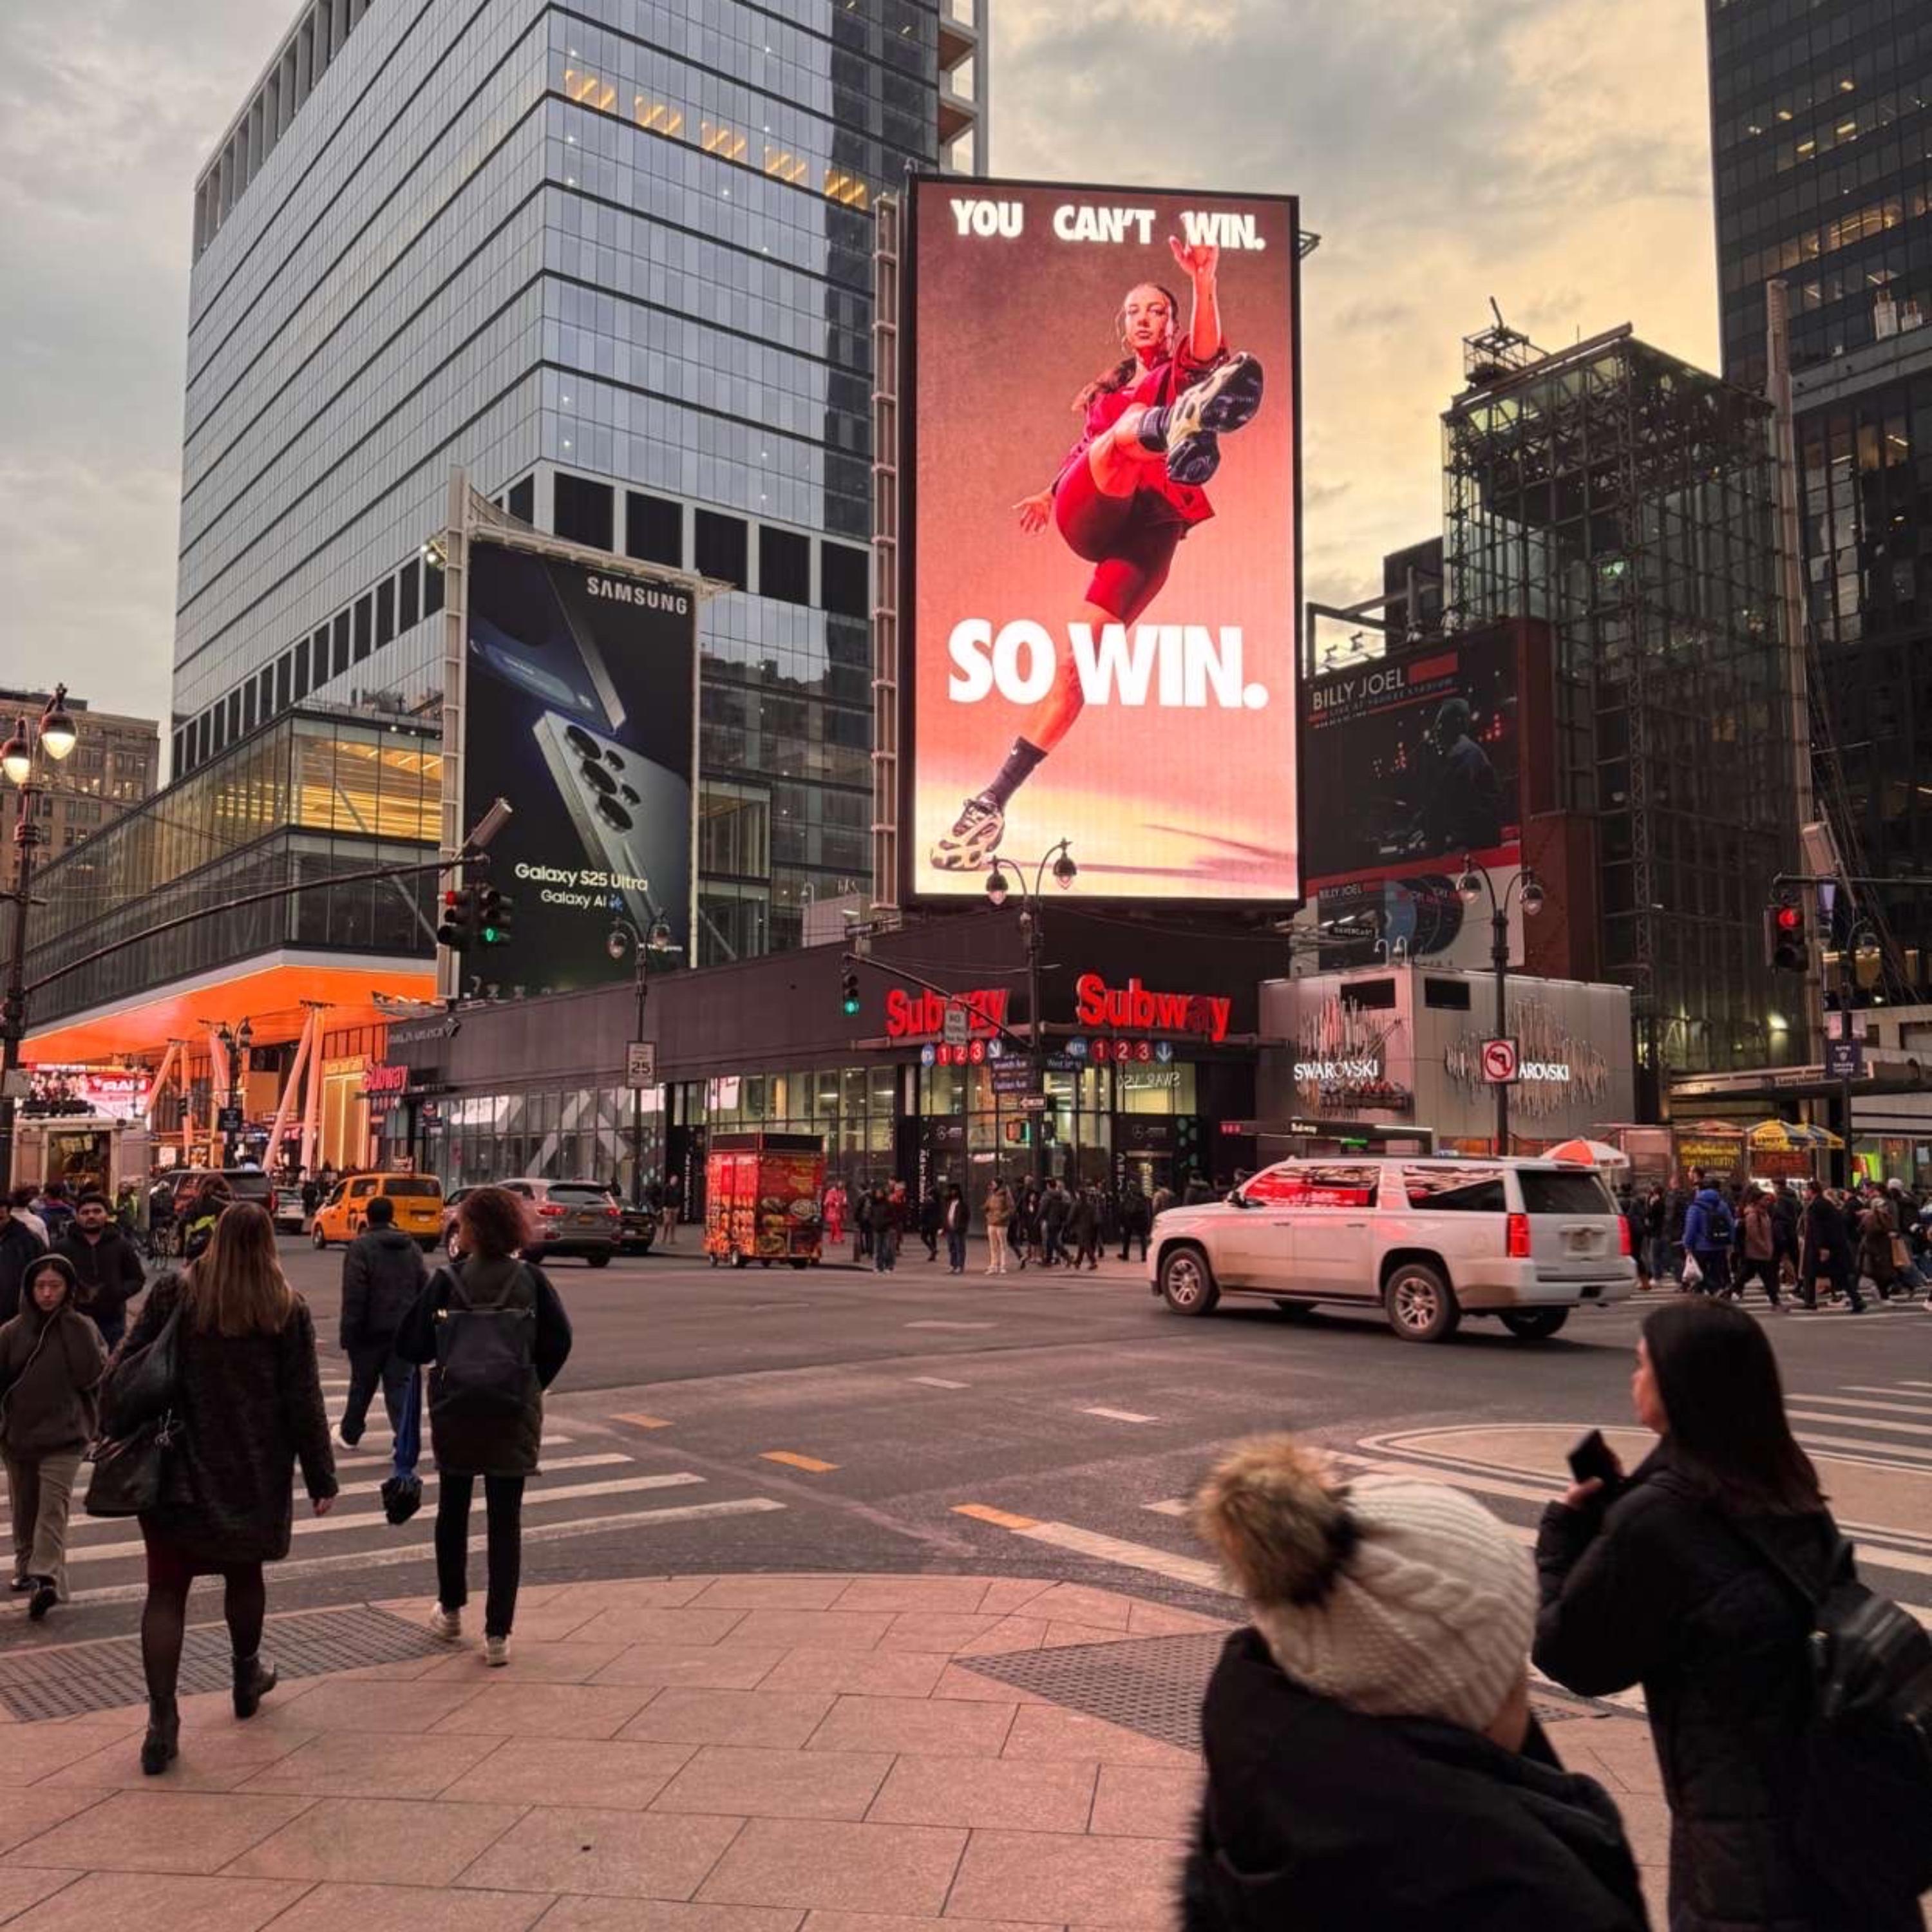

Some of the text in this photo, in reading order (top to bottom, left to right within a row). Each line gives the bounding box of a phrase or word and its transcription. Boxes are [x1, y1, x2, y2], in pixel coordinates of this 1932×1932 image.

[951, 199, 1265, 251] YOU CAN'T WIN.
[587, 576, 687, 615] SAMSUNG
[948, 618, 1269, 709] SO WIN.
[1312, 667, 1405, 710] BILLY JOEL
[515, 863, 648, 891] Galaxy S25 Ultra
[1342, 884, 1362, 896] JOEL
[540, 889, 607, 909] Galaxy AI
[886, 988, 1009, 1039] Subay
[1076, 973, 1231, 1043] Subway
[365, 1065, 408, 1094] Subway
[632, 1062, 650, 1074] 25
[1294, 1059, 1379, 1081] SWAROVSKI
